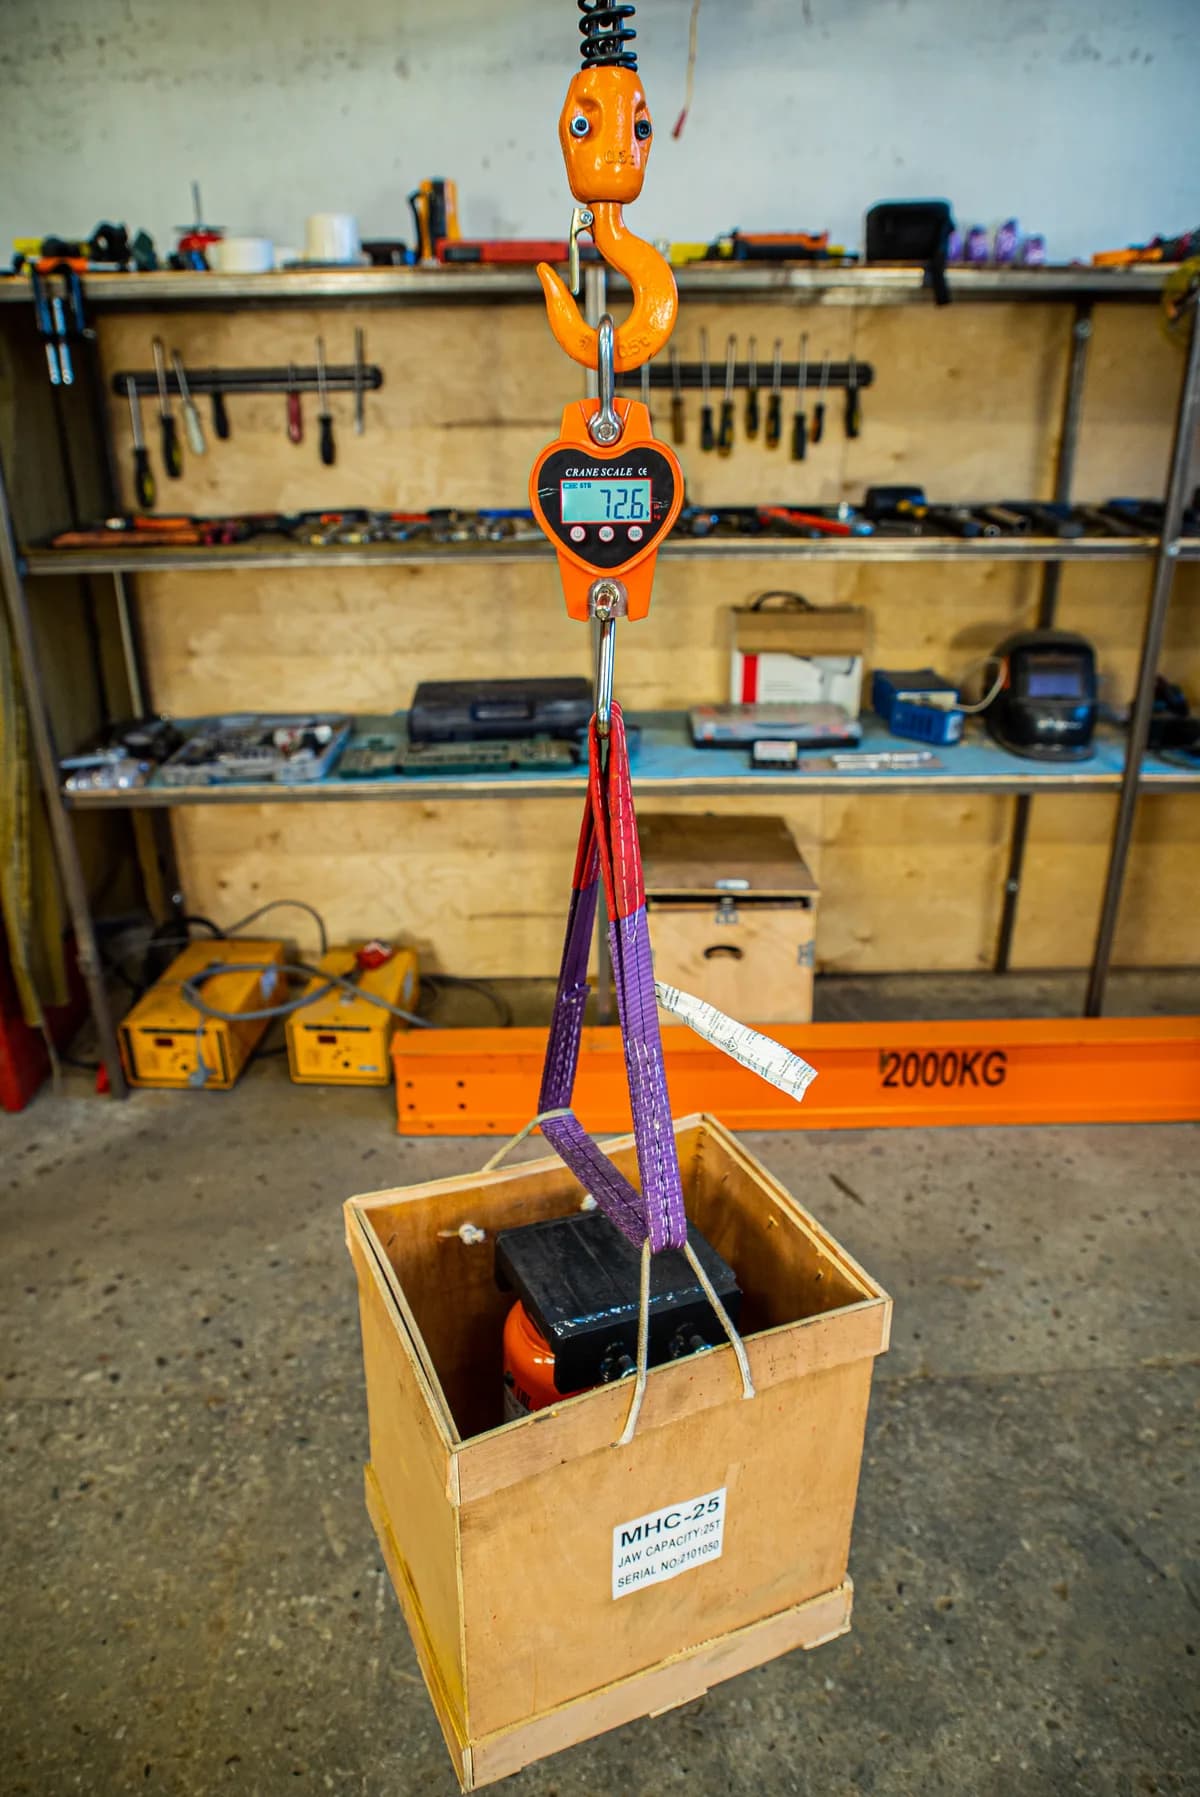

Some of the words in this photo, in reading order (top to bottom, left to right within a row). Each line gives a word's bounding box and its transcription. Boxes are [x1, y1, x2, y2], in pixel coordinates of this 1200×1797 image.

[565, 468, 599, 477] CRANE
[600, 467, 633, 477] SCALE
[600, 488, 644, 519] 72.6
[882, 1050, 1008, 1088] 2000KG
[621, 1496, 720, 1547] MHC-25
[617, 1565, 657, 1588] SERIAL
[660, 1539, 720, 1571] NO:2101050
[618, 1551, 642, 1568] JAW
[645, 1519, 720, 1557] CAPACITY:25T
